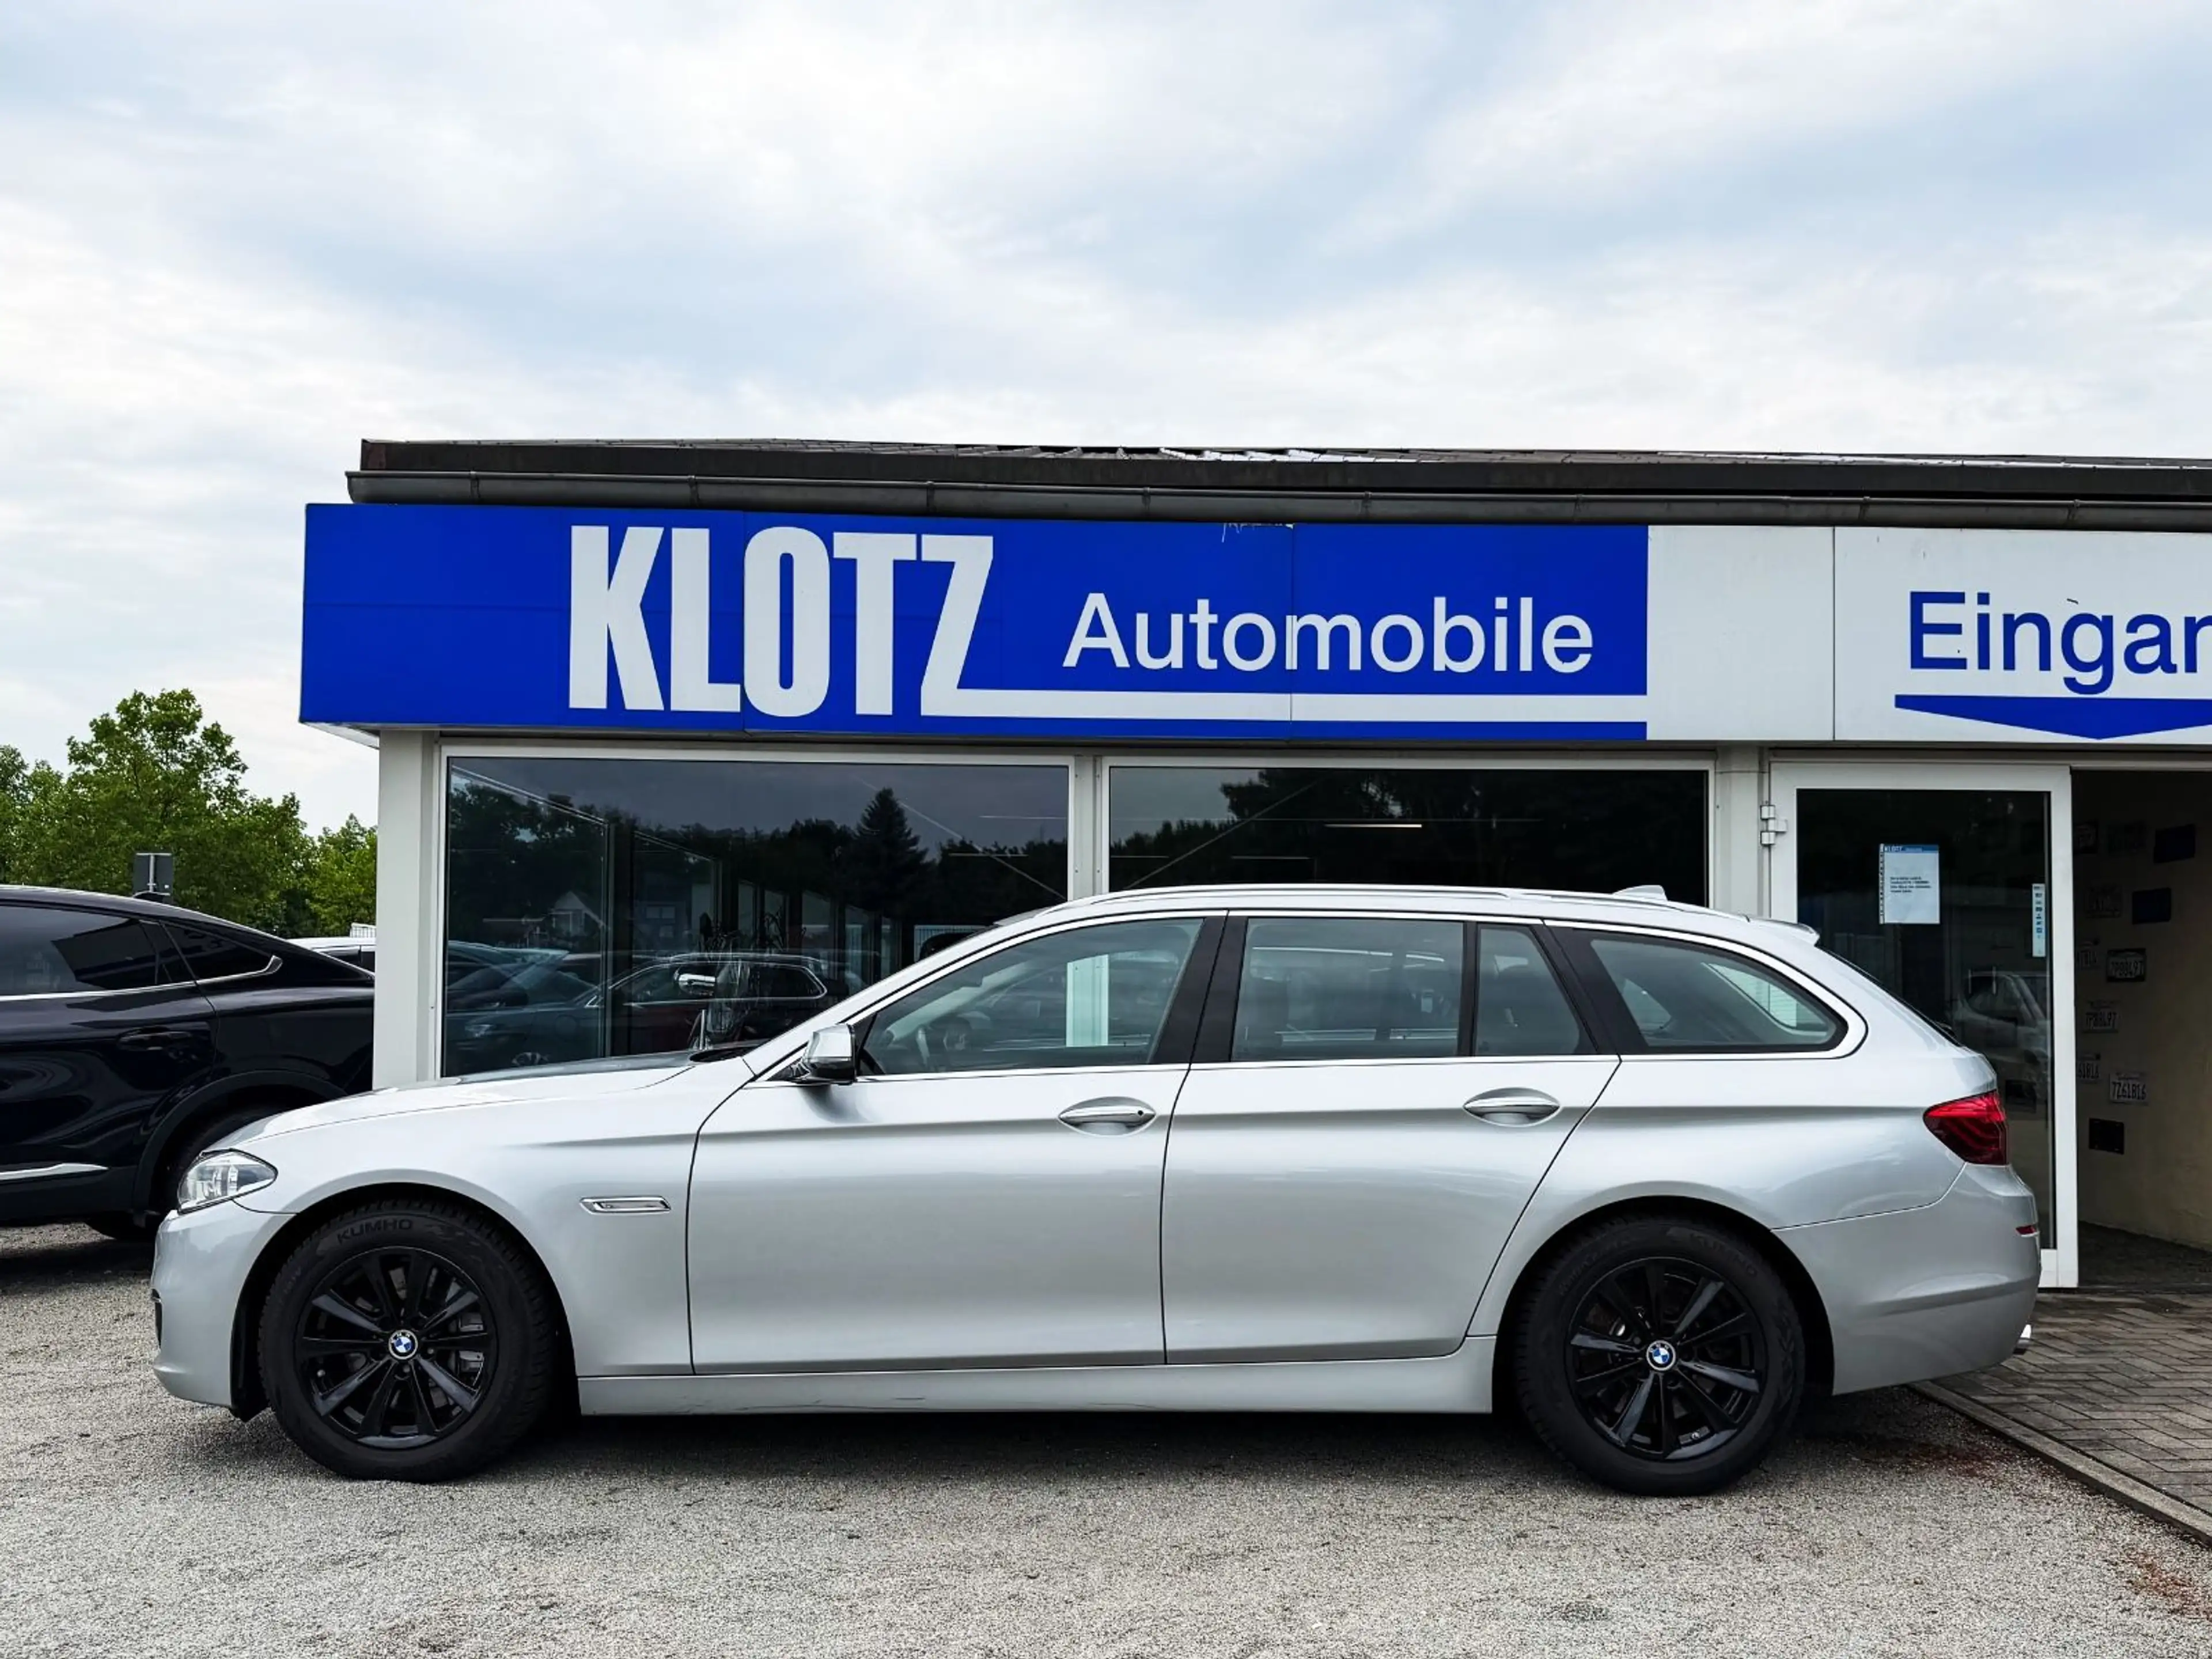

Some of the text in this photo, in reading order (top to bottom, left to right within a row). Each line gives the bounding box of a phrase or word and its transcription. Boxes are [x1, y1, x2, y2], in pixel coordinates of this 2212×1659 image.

[569, 525, 1593, 717] KLOTZ Automobile
[337, 1219, 412, 1244] KUMHO
